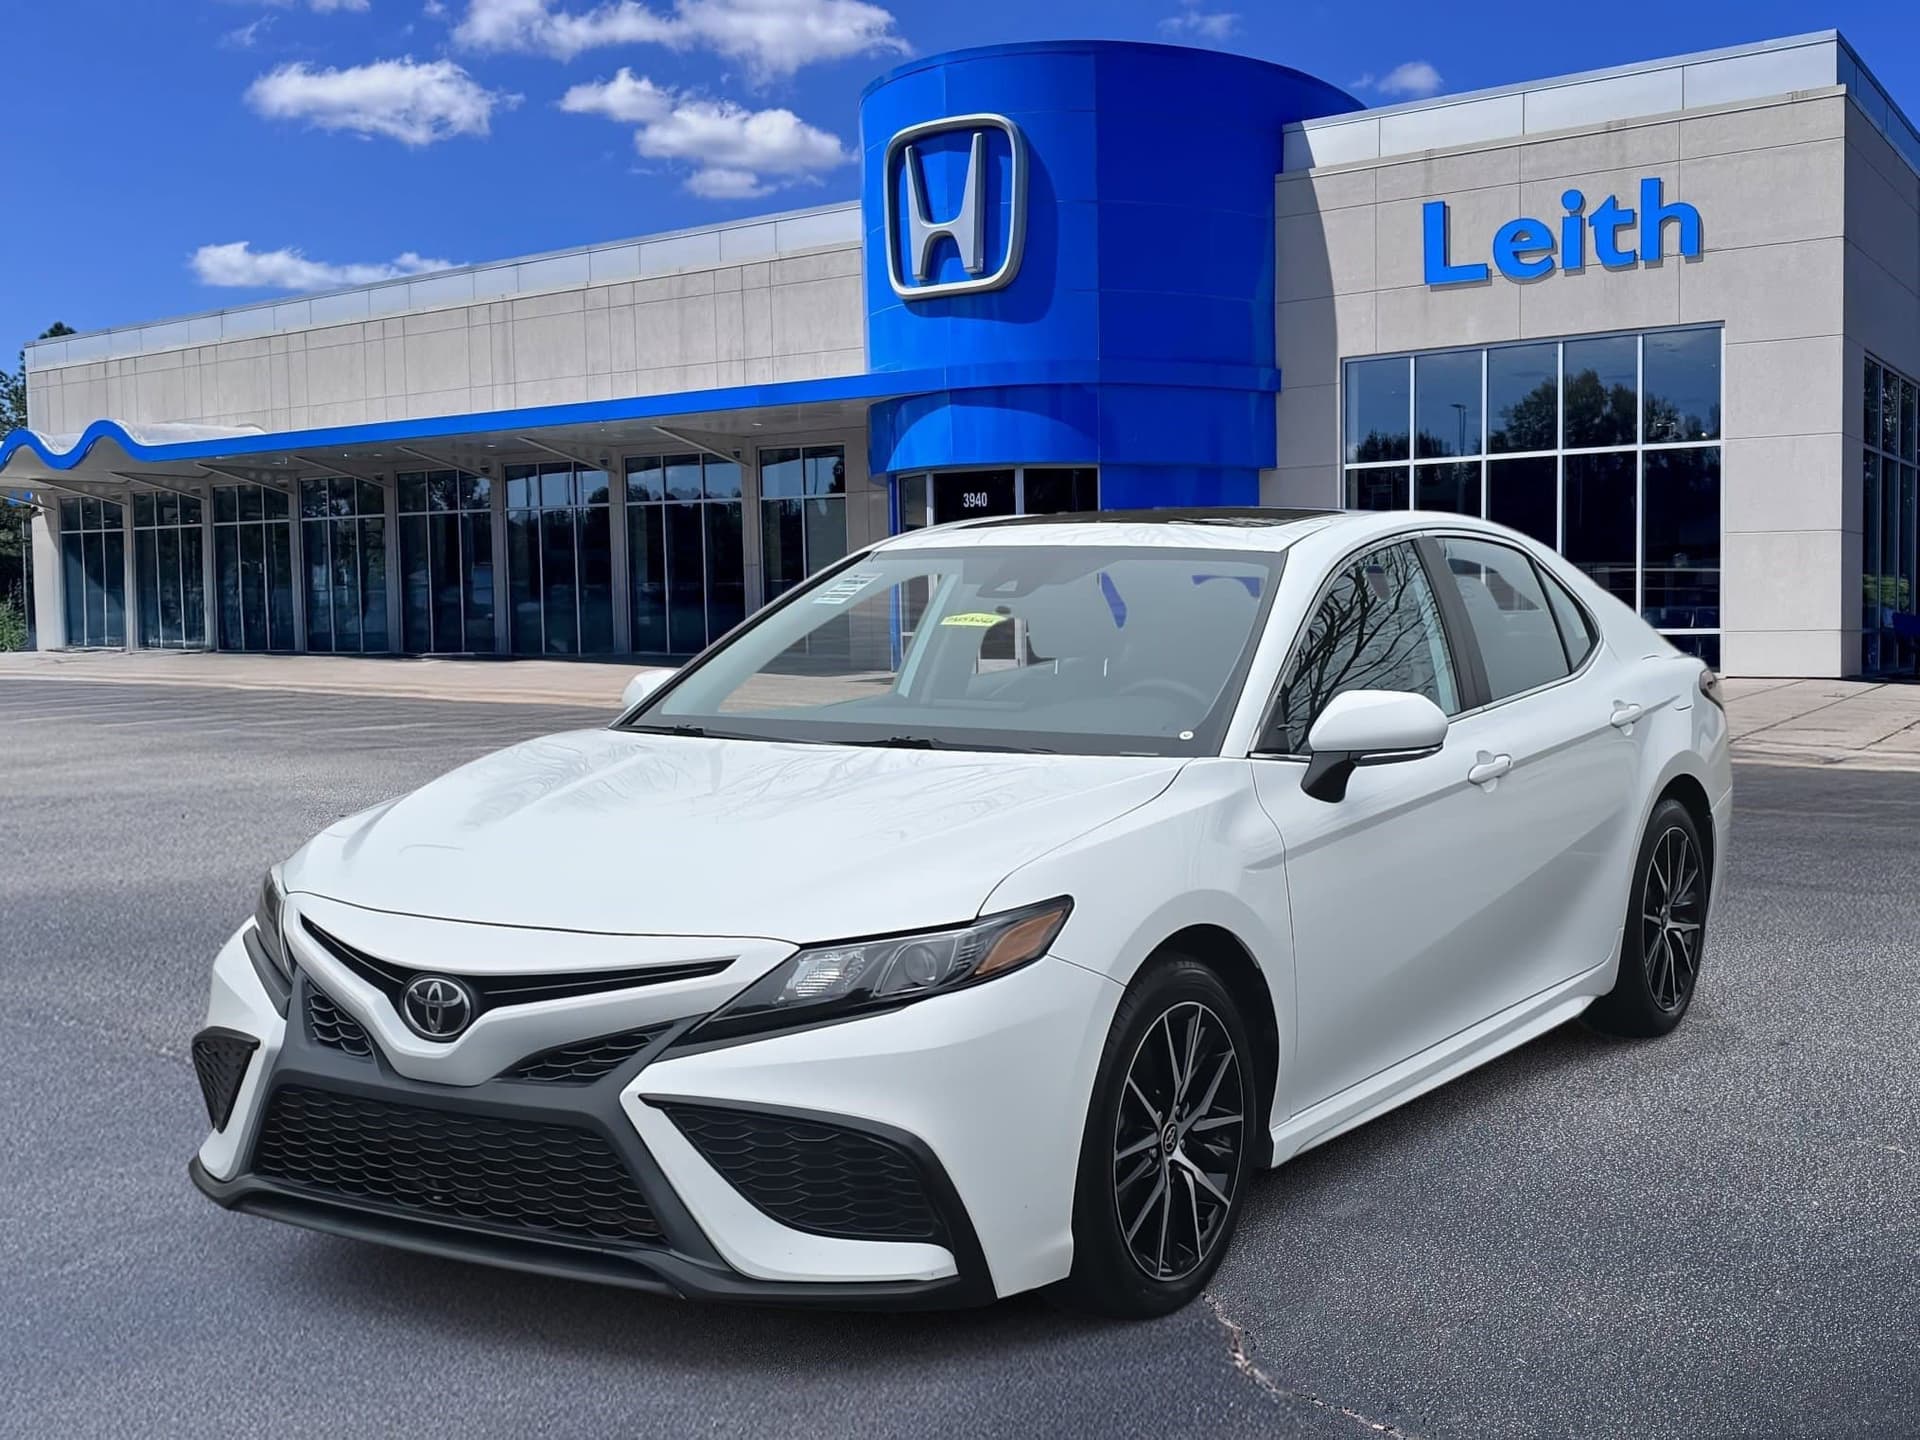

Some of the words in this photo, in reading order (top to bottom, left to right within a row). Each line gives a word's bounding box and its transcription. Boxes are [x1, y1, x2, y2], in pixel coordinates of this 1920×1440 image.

[905, 132, 984, 283] H
[1422, 176, 1702, 286] Leith
[963, 491, 988, 508] 3940
